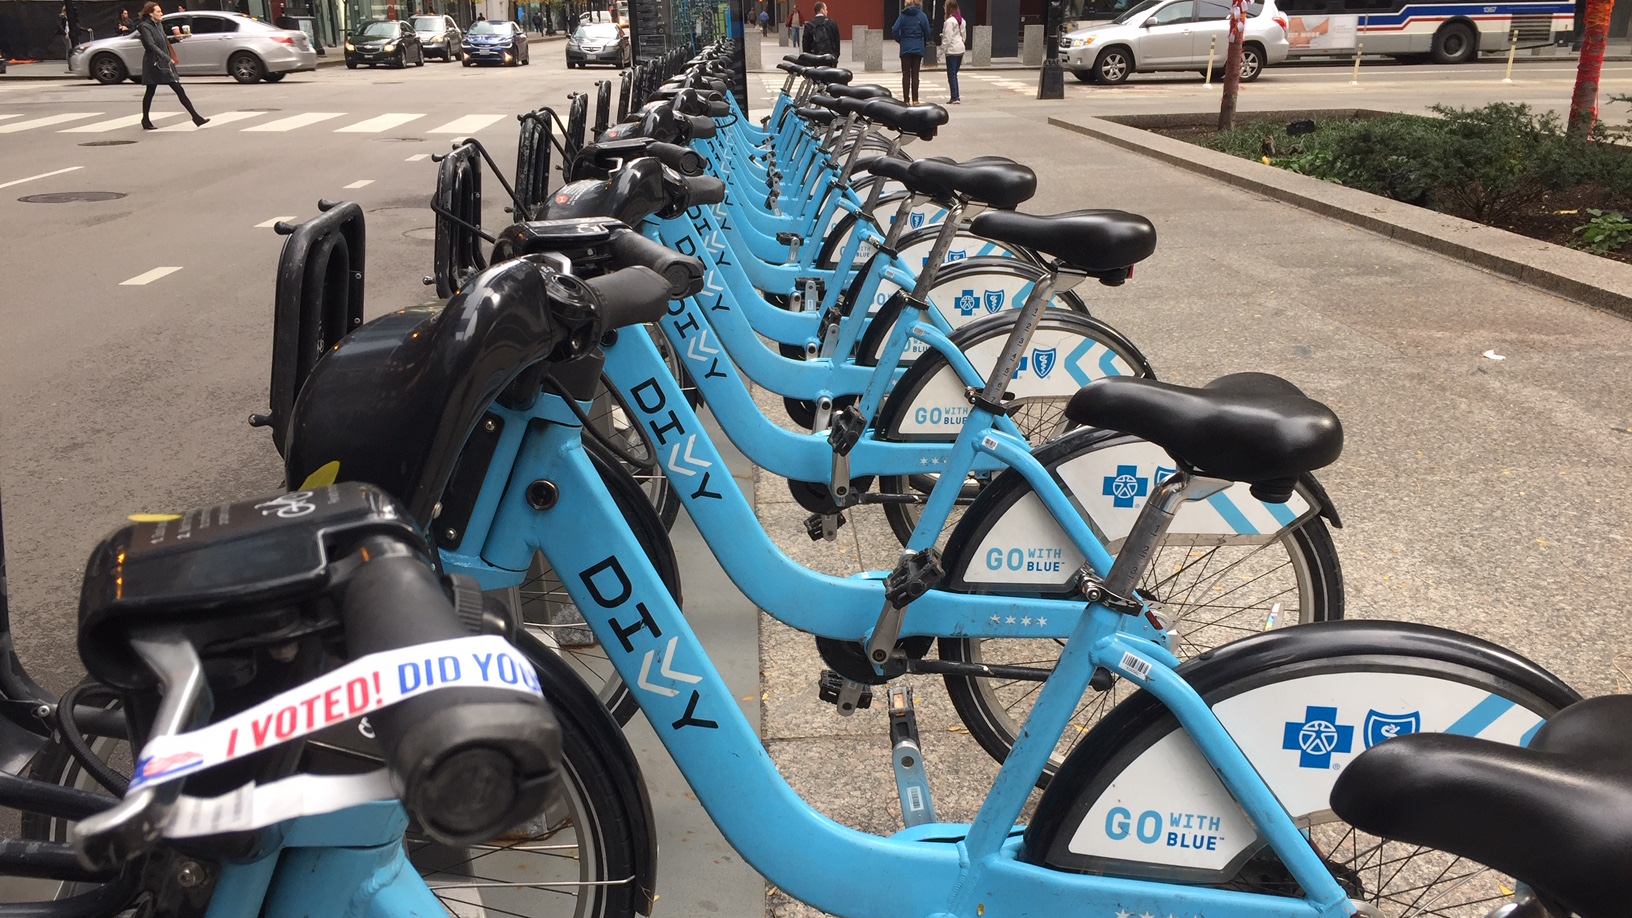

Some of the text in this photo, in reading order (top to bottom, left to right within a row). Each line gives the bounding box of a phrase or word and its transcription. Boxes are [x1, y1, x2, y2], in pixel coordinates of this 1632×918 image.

[914, 406, 969, 425] GO WITH
[986, 547, 1062, 572] GO WITH
[227, 728, 239, 758] I
[250, 671, 384, 750] VOTED!
[398, 655, 461, 694] DID
[1105, 806, 1221, 844] GO WITH
